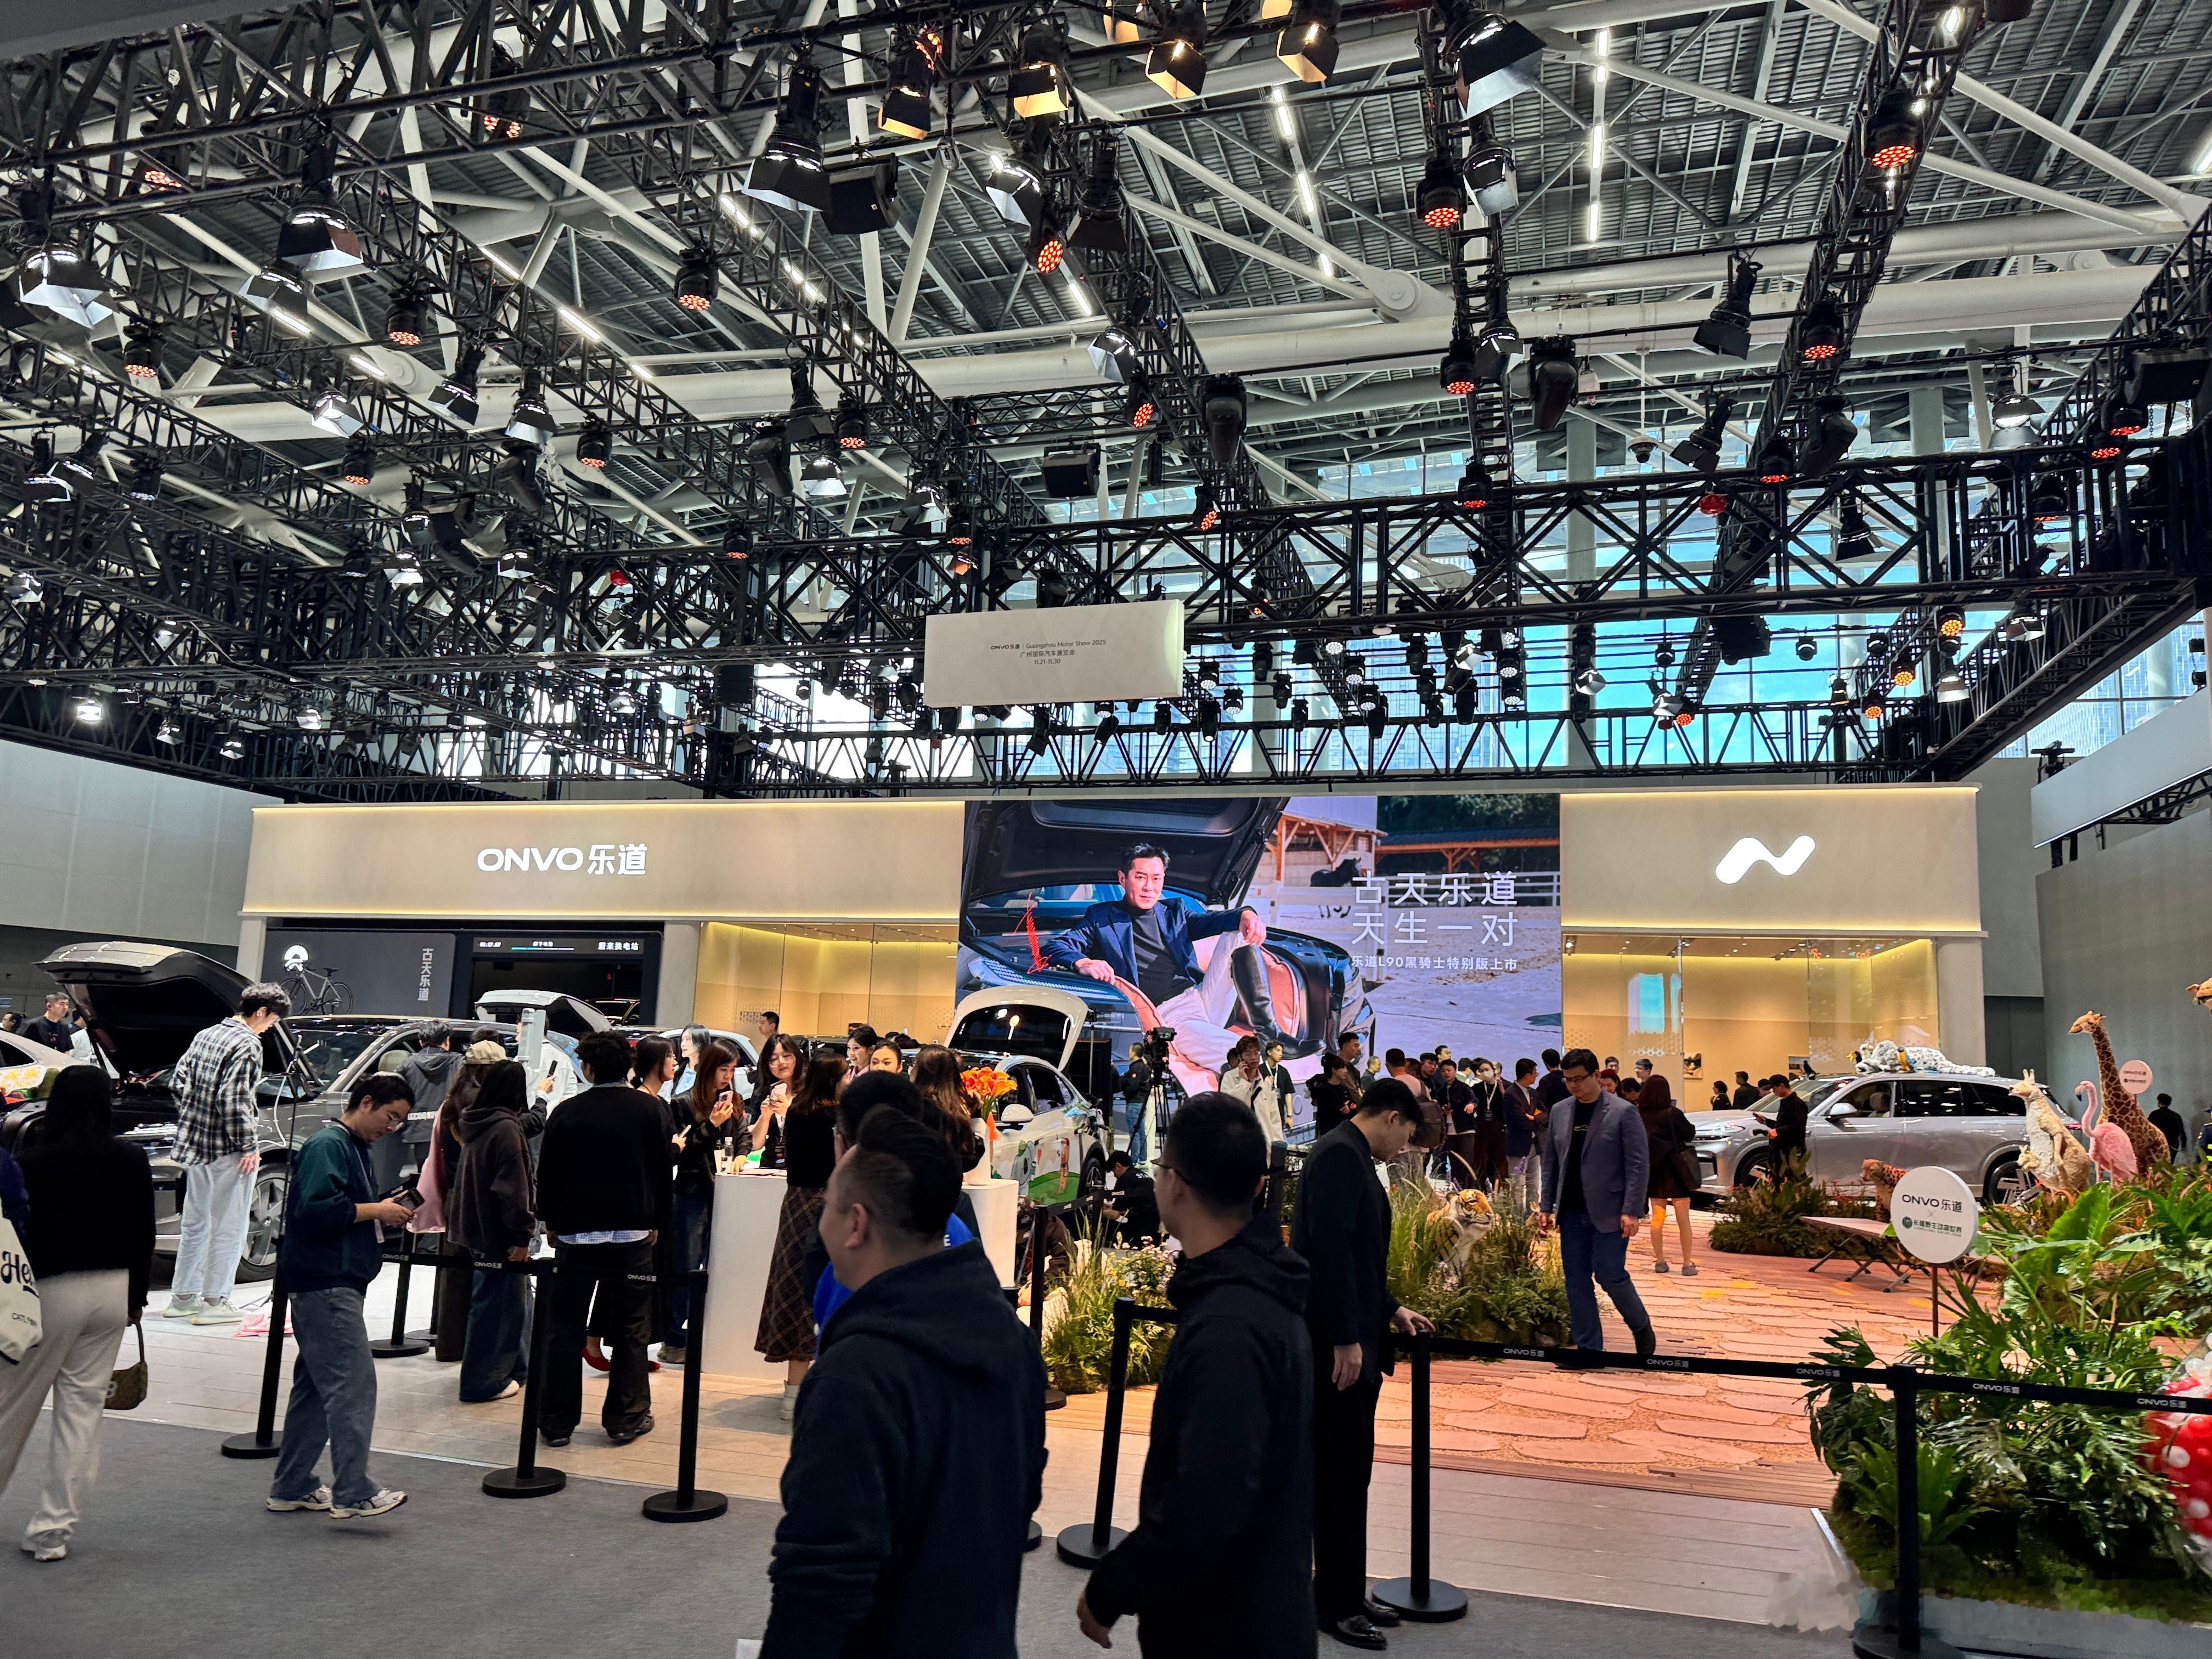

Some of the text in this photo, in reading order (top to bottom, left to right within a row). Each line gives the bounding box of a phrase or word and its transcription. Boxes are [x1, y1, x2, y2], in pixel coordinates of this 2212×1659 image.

[1020, 650, 1076, 658] 广州国际汽车展览会
[1351, 871, 1518, 906] 古天乐道
[1351, 911, 1519, 947] 天生一对
[597, 941, 639, 951] 蔚来换电站
[417, 948, 434, 1001] 古天乐道
[1350, 955, 1518, 970] 乐道L90黑骑士特别版上市
